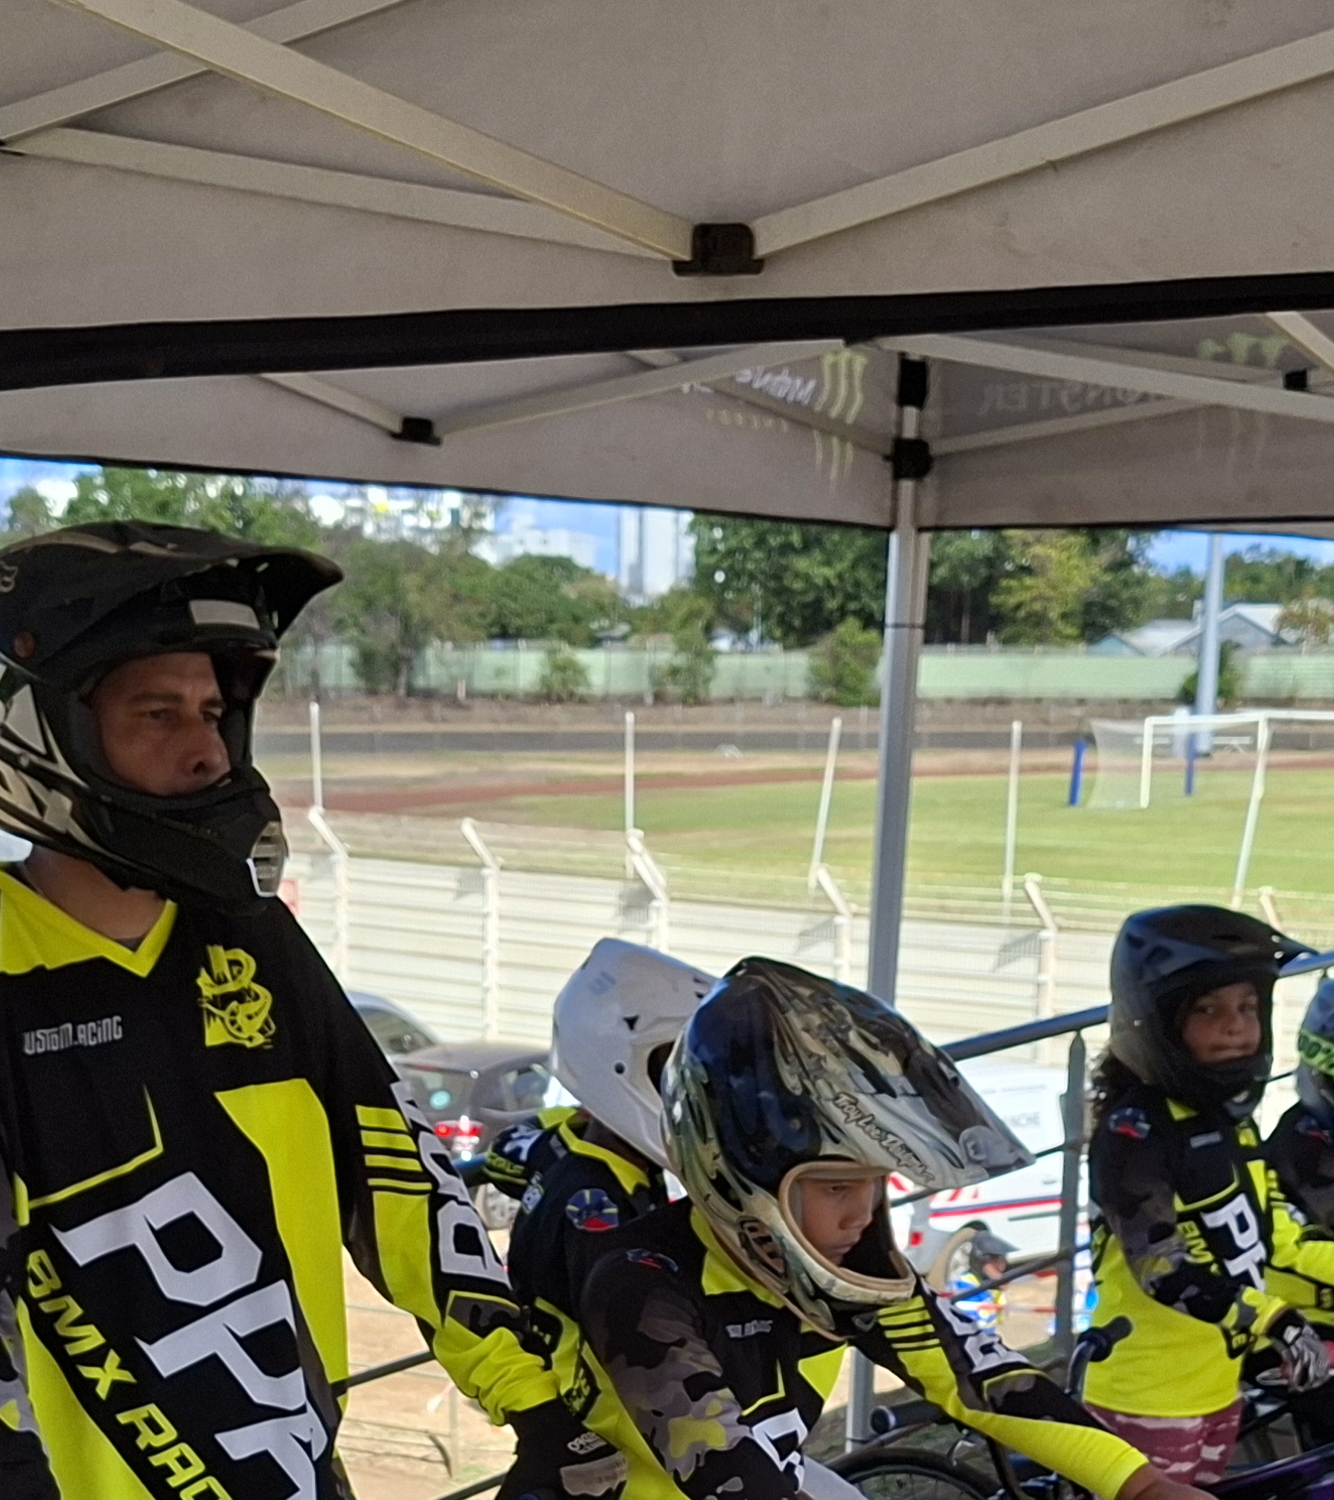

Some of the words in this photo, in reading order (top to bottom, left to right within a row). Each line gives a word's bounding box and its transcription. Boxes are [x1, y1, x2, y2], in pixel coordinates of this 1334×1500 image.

[833, 1091, 860, 1125] Troy
[858, 1113, 881, 1141] Lee
[26, 1248, 138, 1401] BMX
